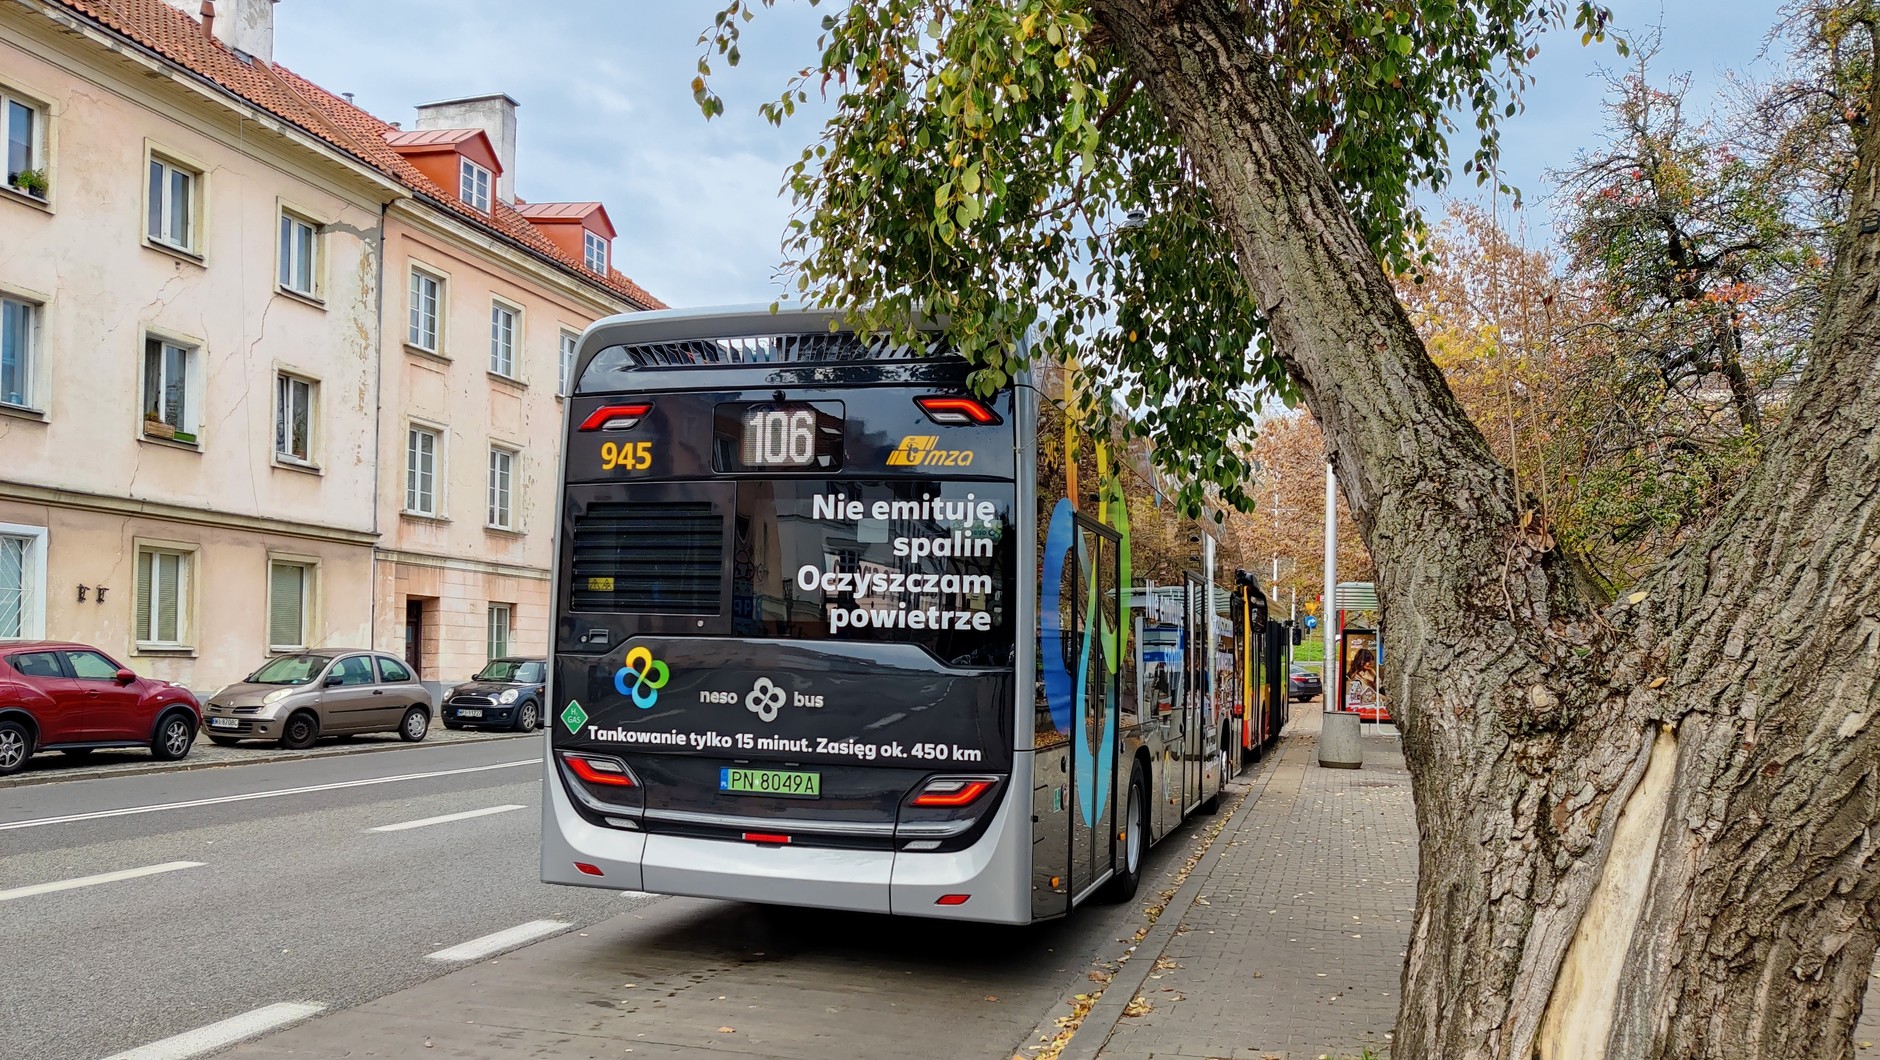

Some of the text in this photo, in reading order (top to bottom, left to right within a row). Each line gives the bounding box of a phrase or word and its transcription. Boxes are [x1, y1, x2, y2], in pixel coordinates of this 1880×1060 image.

[750, 411, 813, 463] 106
[601, 442, 652, 470] 945
[924, 450, 974, 466] mza
[812, 493, 995, 528] Nie emituję
[893, 530, 993, 563] spalin
[797, 564, 992, 599] Oczyszczam
[830, 602, 992, 634] powietrze
[700, 690, 824, 708] neso bus
[567, 715, 581, 724] GAS
[588, 725, 982, 762] Tankowanie tylko 15 minut. Zasięg ok. 450 km
[731, 771, 815, 794] PN 8049A
